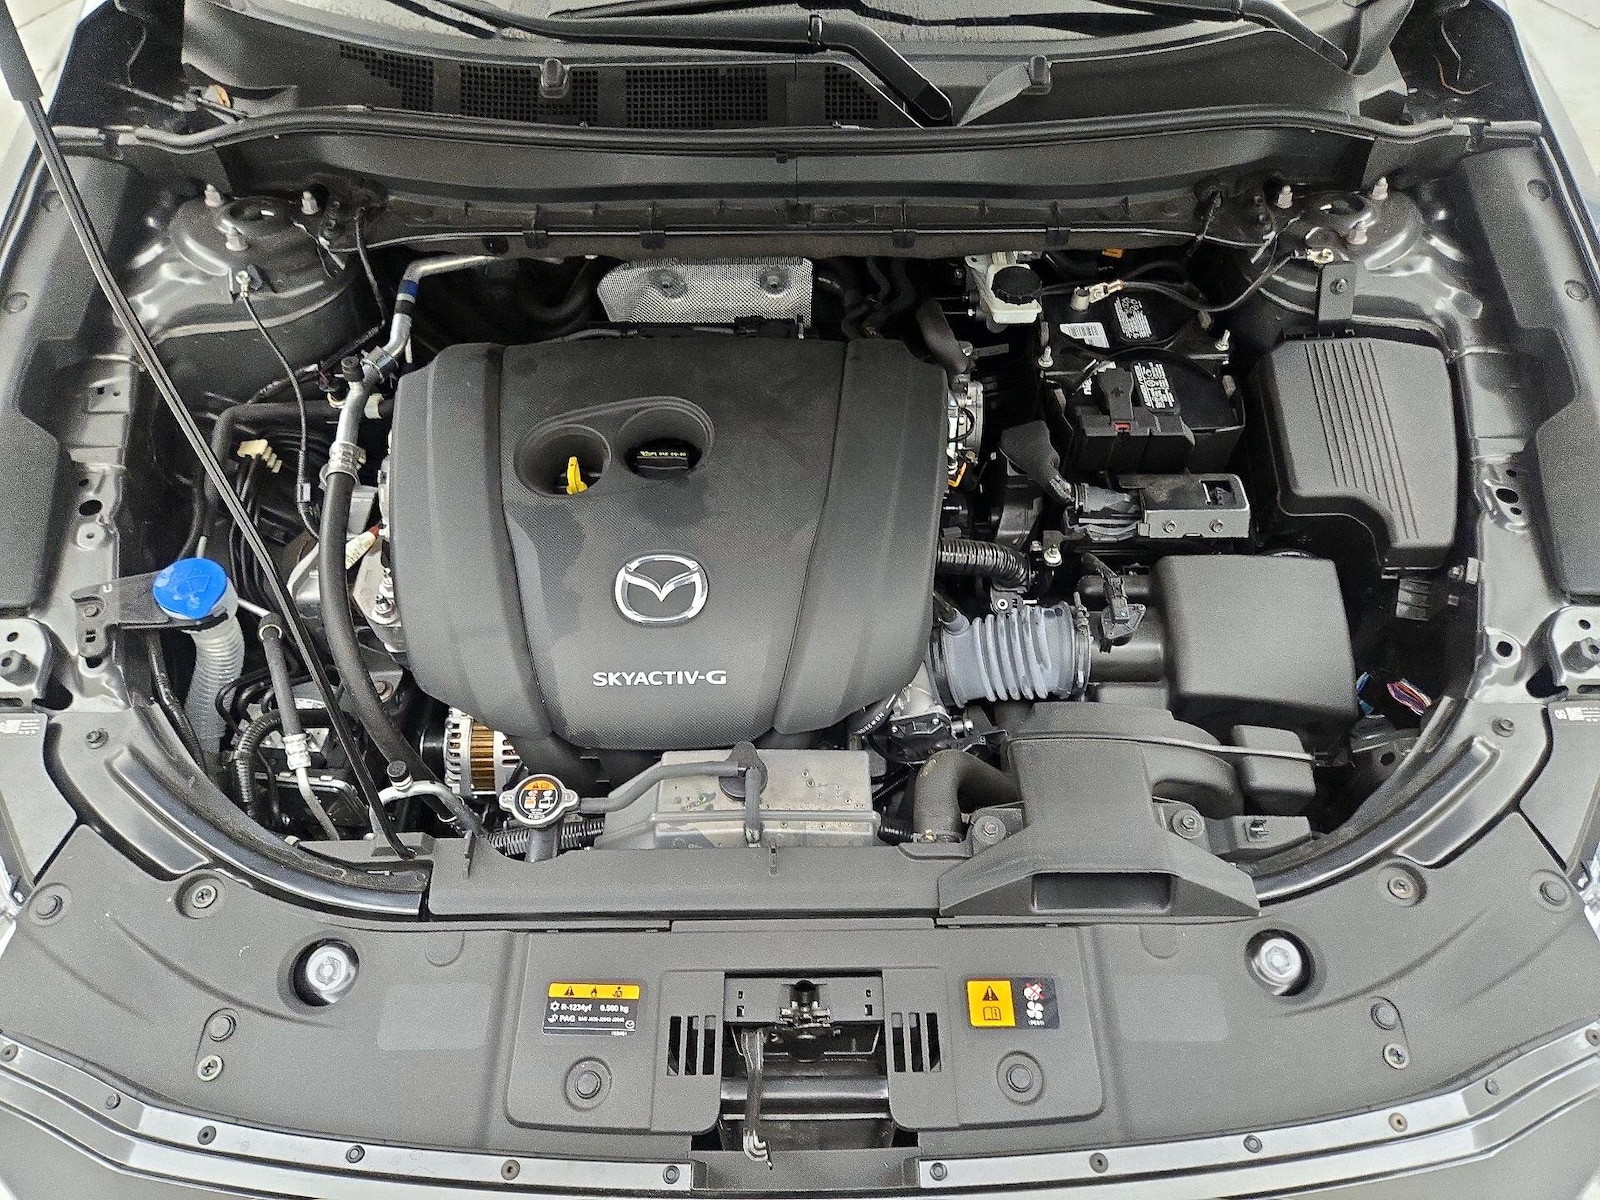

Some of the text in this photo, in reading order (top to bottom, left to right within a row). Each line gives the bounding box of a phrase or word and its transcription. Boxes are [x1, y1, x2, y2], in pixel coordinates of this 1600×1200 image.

[593, 670, 727, 687] SKYACTIV-G
[561, 1003, 592, 1013] R-1234yf
[620, 1005, 629, 1014] kg
[559, 1015, 576, 1023] PAG
